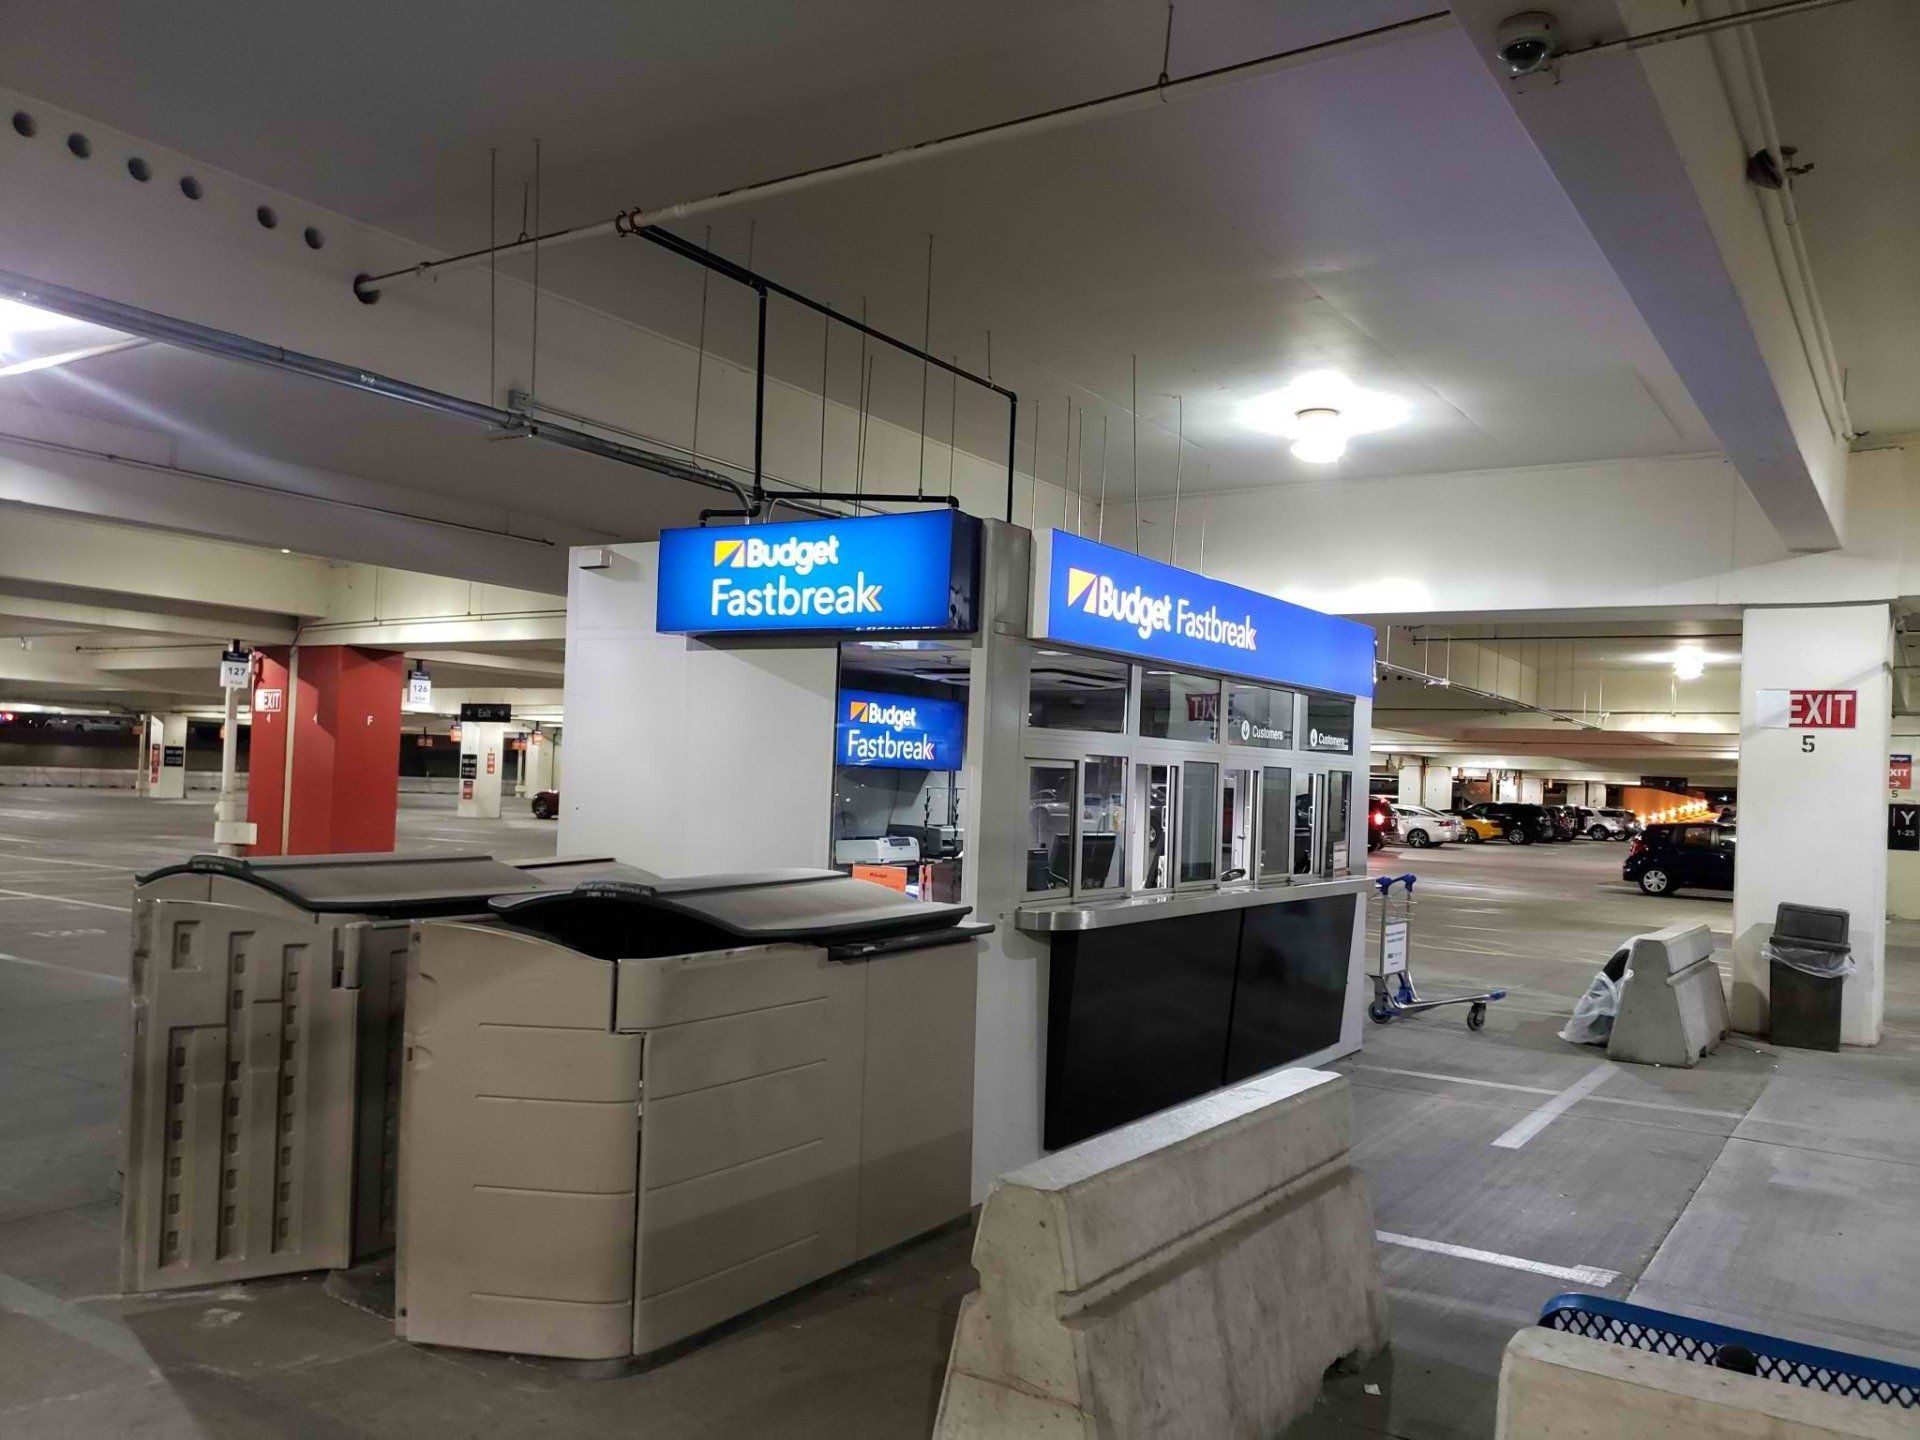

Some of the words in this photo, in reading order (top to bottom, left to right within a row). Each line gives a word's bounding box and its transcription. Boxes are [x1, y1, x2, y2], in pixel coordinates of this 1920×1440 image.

[746, 535, 840, 575] Budget
[711, 571, 878, 616] Fastbreak
[1098, 575, 1171, 639] Budget
[1176, 598, 1256, 649] Fastbreak
[228, 667, 246, 676] 127
[413, 684, 427, 693] 126
[264, 692, 280, 709] EXIT
[1788, 693, 1853, 725] EXIT
[367, 715, 374, 726] F
[869, 702, 917, 732] Budget
[1252, 725, 1284, 741] Customers
[848, 729, 933, 761] Fastbreak
[1801, 735, 1815, 753] 5
[1889, 768, 1909, 777] XIT
[1900, 810, 1916, 826] Y
